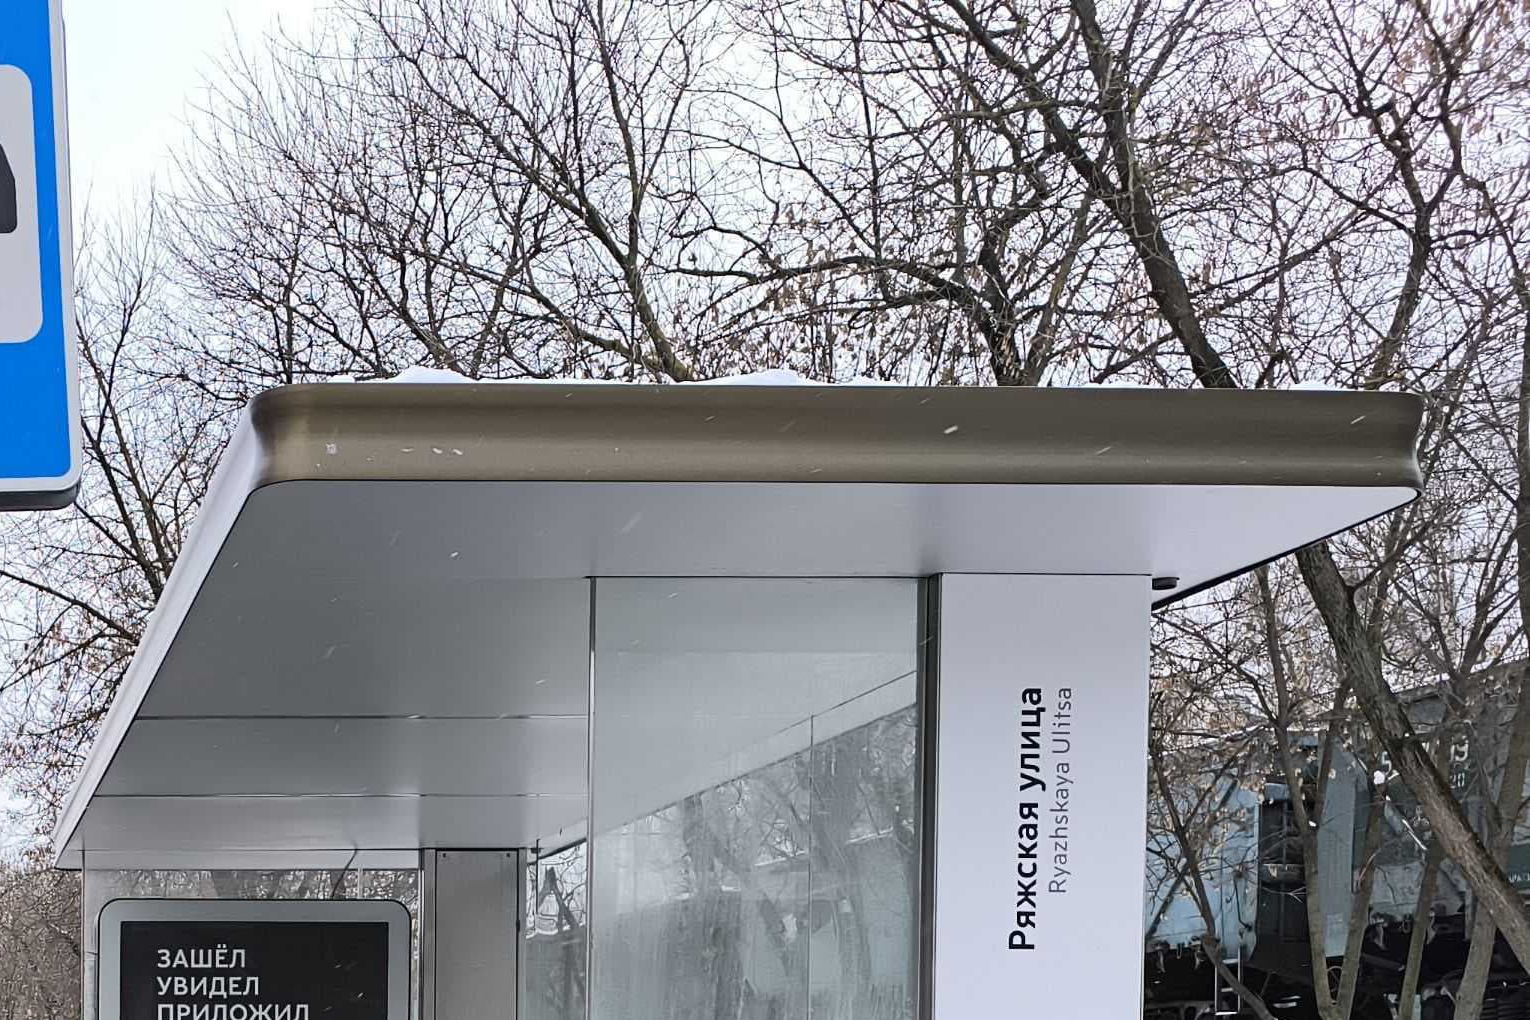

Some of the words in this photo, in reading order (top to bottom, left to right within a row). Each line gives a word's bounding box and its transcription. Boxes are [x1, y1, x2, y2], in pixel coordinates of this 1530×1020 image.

[1019, 687, 1047, 793] улица
[1051, 687, 1072, 754] Ulitsa
[1048, 762, 1074, 893] Ryazhskaya
[1008, 802, 1039, 950] Ряжская
[157, 944, 246, 968] ЗАШЁЛ
[157, 977, 259, 999] УВИДЕЛ
